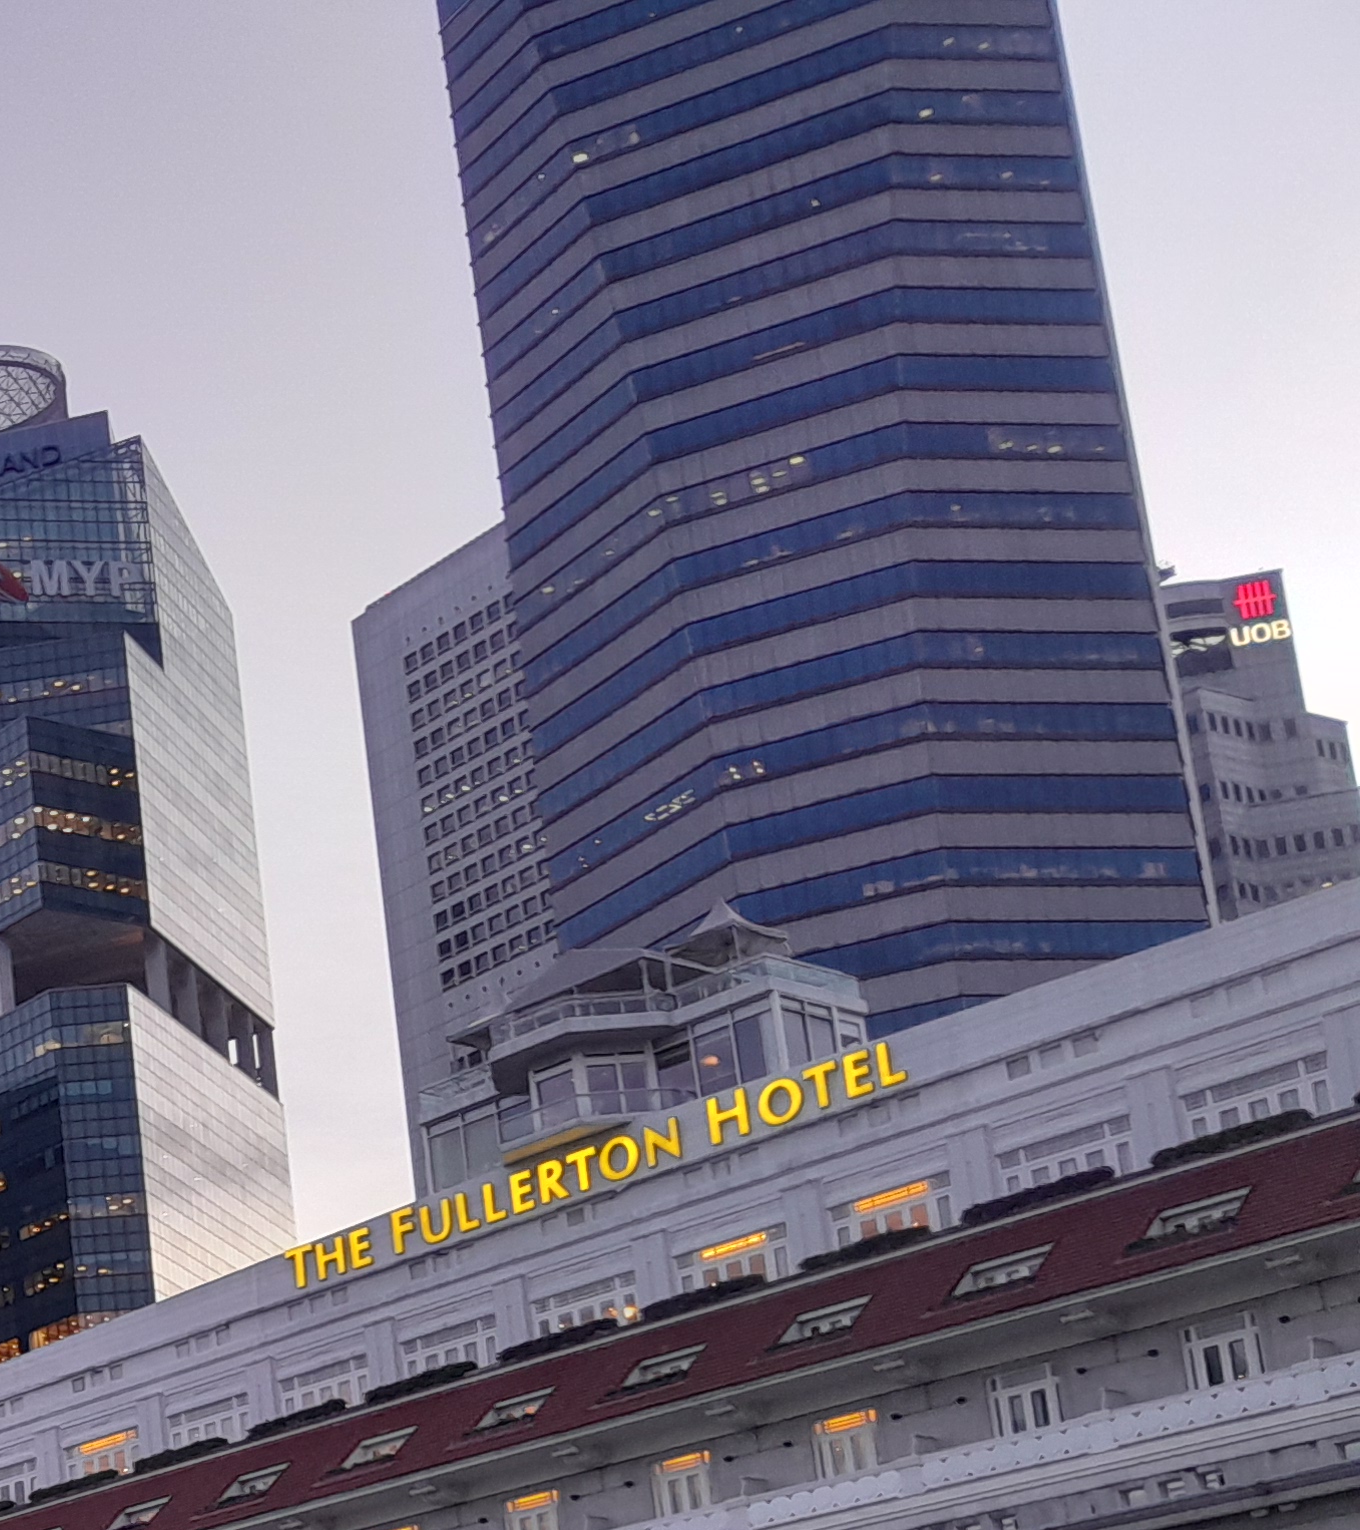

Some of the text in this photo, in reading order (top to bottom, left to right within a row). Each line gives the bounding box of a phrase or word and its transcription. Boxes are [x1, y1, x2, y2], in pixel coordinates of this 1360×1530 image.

[30, 559, 137, 597] MYP
[1230, 619, 1292, 647] UOB
[284, 1041, 908, 1290] THE FULLERTON HOTEL
